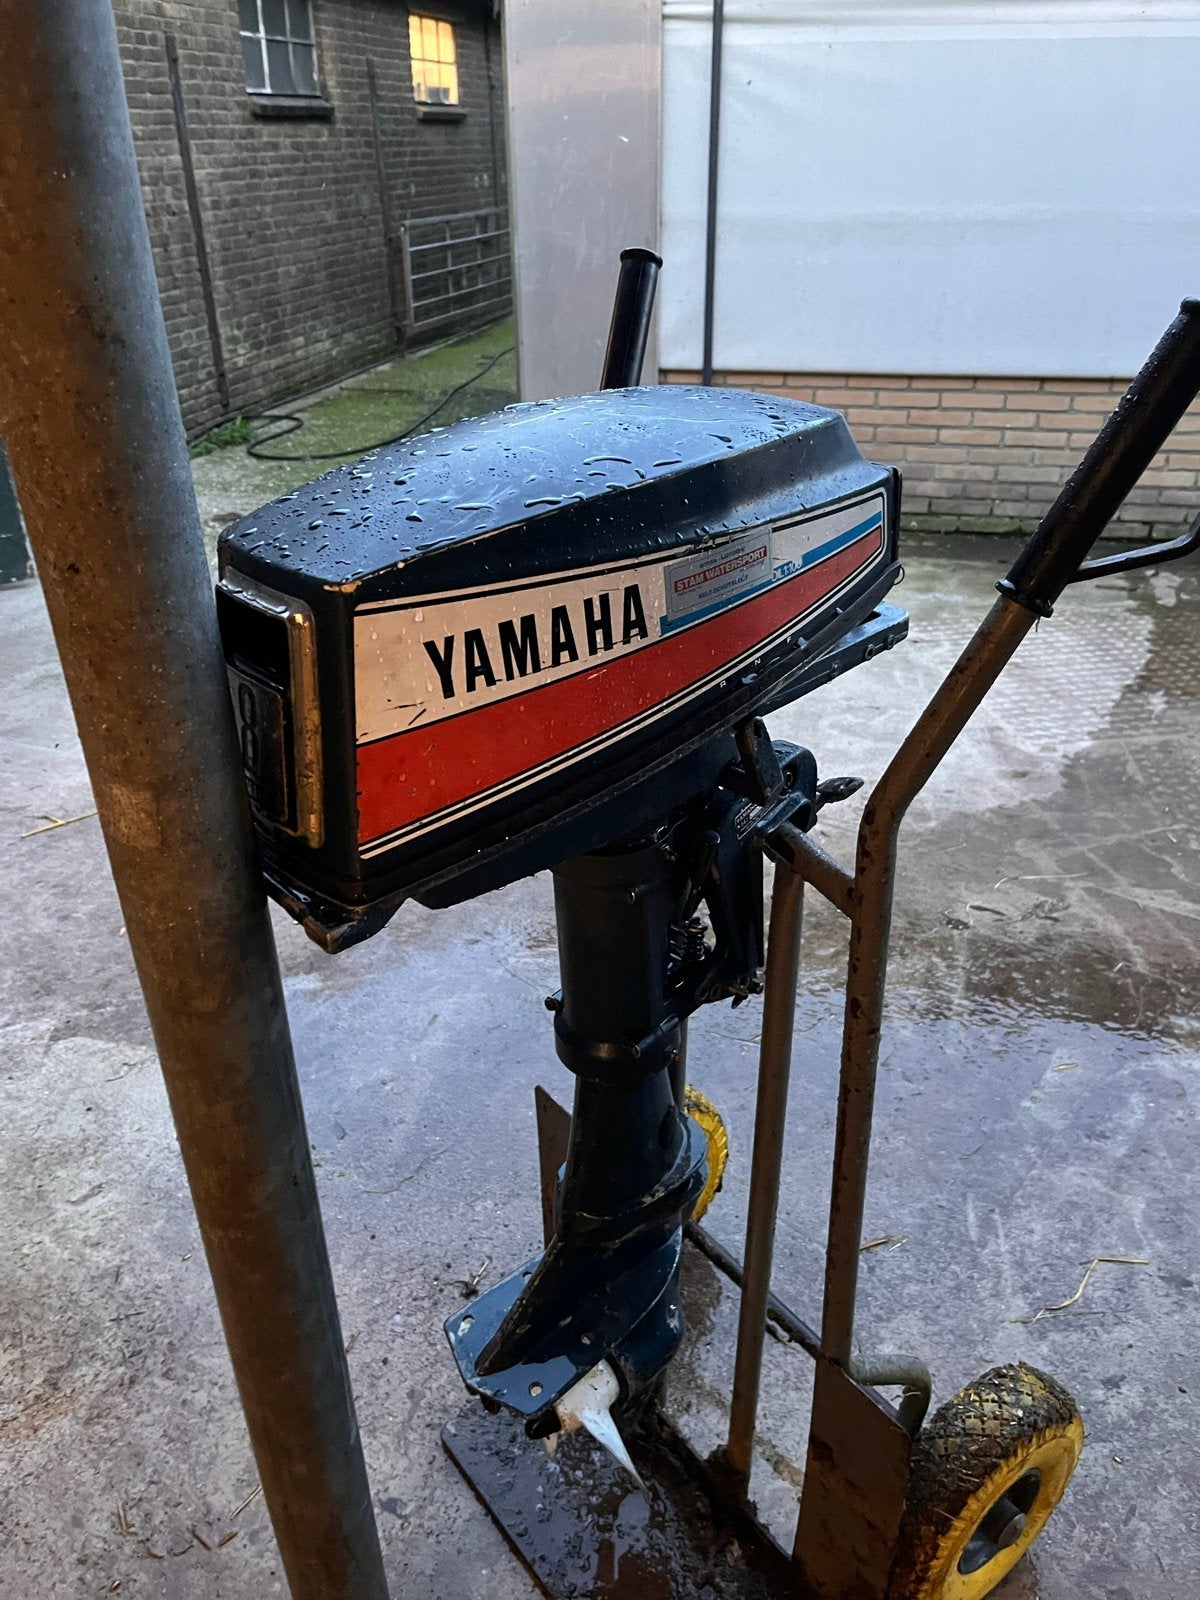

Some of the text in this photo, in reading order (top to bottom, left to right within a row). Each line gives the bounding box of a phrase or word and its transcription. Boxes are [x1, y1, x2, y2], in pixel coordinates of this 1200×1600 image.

[676, 574, 704, 592] STAM
[706, 548, 765, 579] WATERSPORT
[423, 584, 648, 699] YAMAHA
[719, 636, 792, 689] R N F
